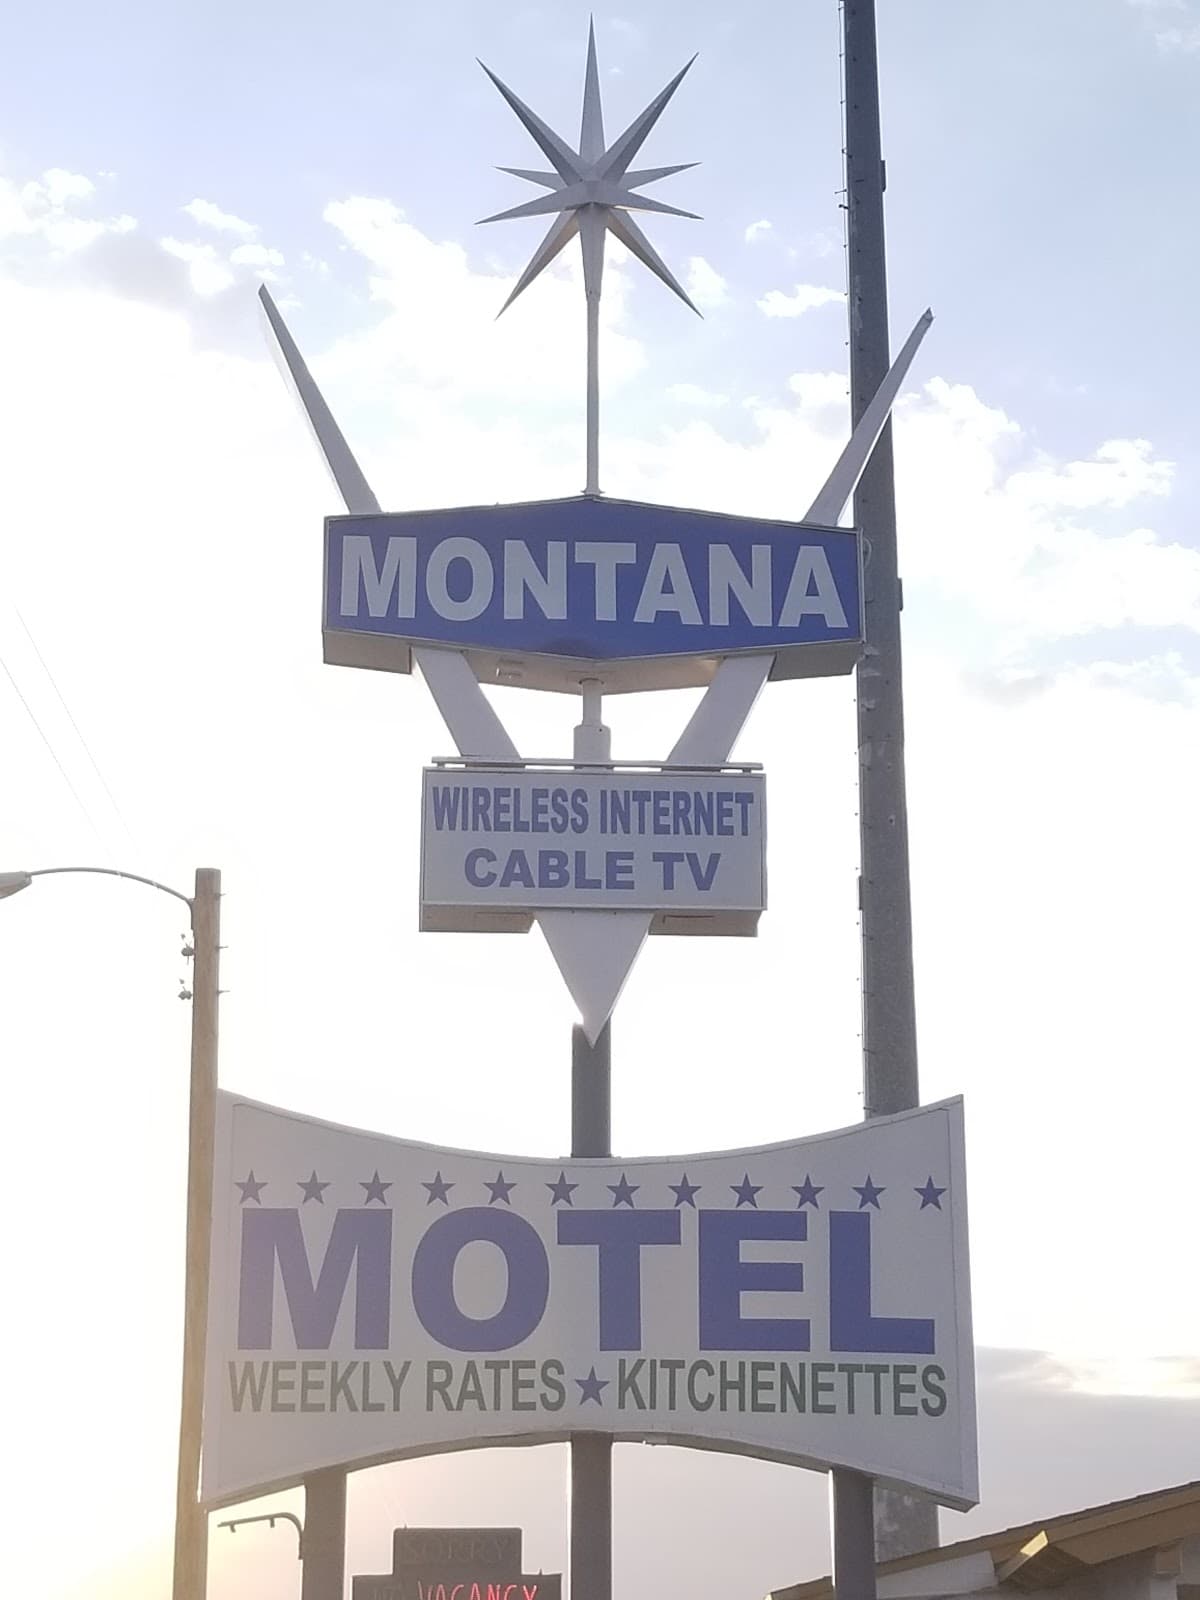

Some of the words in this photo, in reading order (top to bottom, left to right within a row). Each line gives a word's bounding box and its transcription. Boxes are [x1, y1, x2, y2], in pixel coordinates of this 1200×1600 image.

[340, 535, 848, 627] MONTANA
[433, 786, 588, 834] WIRELESS
[600, 789, 754, 836] INTERNET
[464, 848, 635, 889] CABLE
[652, 852, 721, 891] TV
[237, 1206, 935, 1354] MOTEL
[229, 1360, 412, 1412] WEEKLY
[425, 1359, 566, 1412] RATES
[617, 1359, 948, 1418] KITCHENETTES
